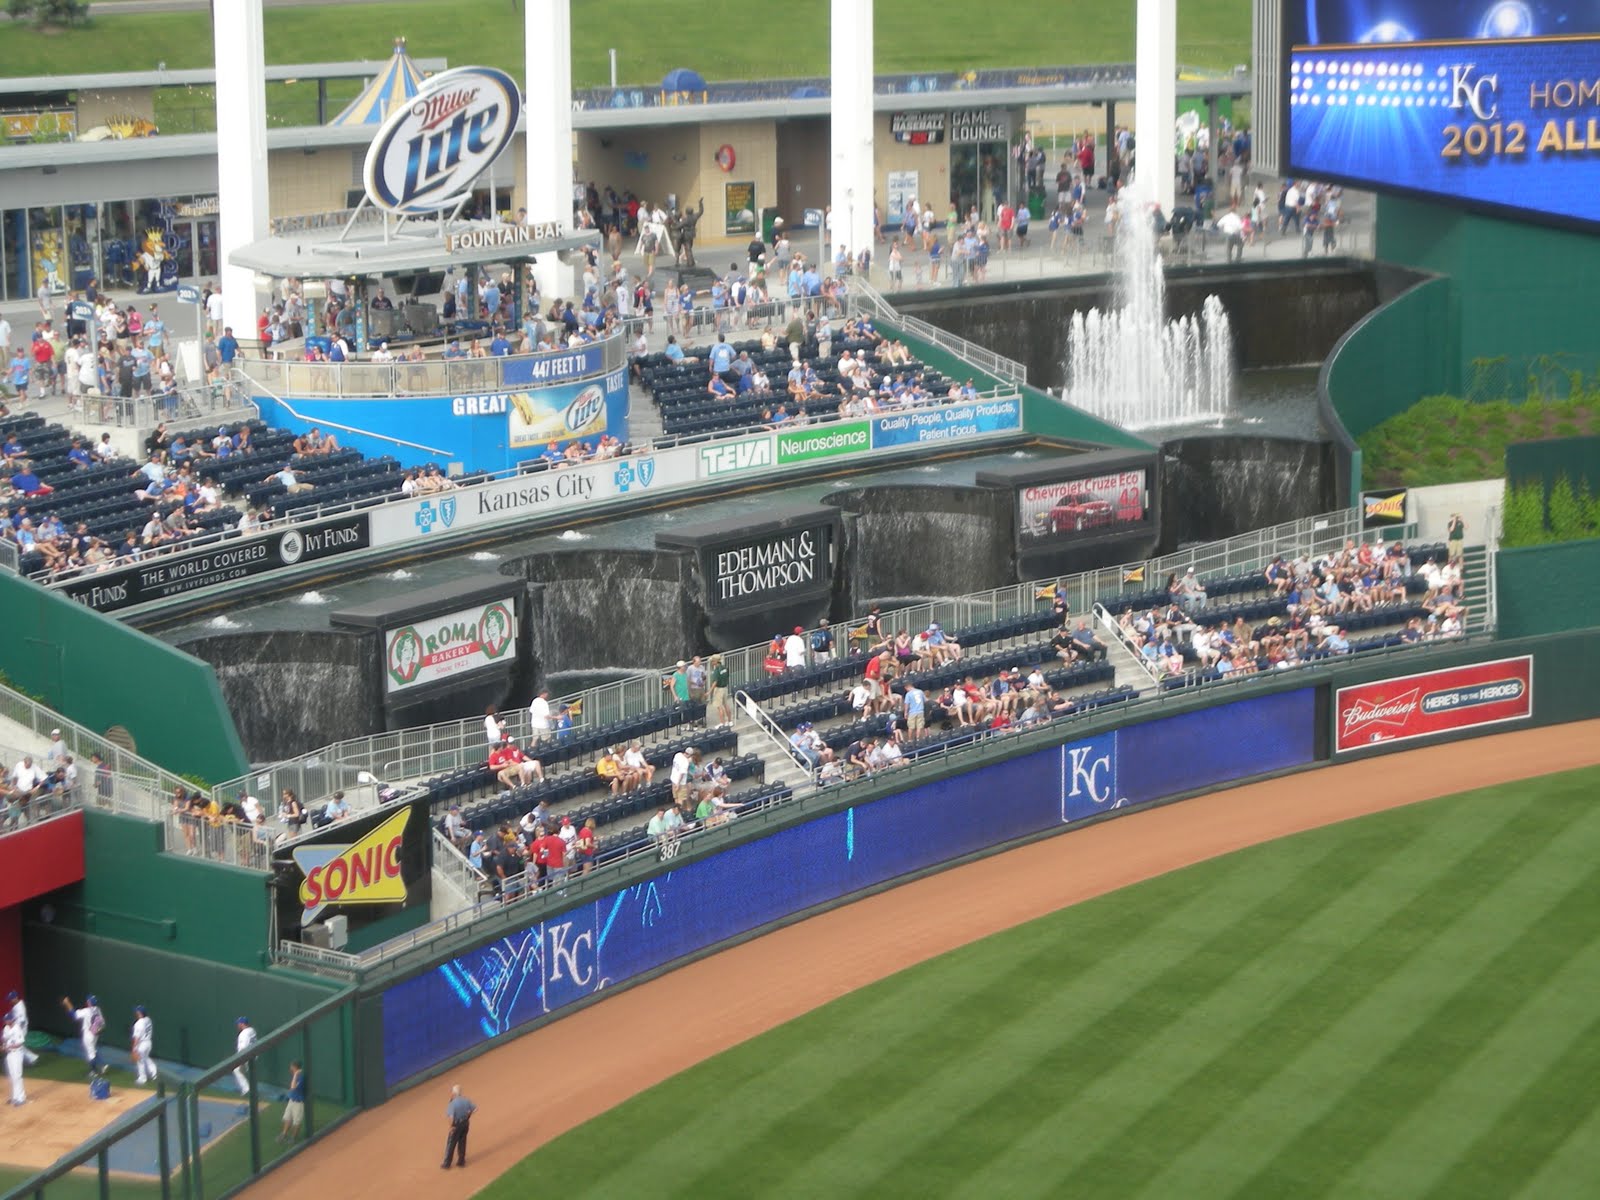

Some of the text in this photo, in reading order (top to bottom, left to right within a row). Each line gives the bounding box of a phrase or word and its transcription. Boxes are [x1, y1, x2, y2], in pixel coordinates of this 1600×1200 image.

[1449, 63, 1497, 120] KC
[1530, 79, 1600, 108] HOM
[412, 87, 480, 126] Miller
[952, 110, 991, 125] GAME
[892, 120, 944, 132] BASEBALL
[952, 124, 1006, 141] LOUNGE
[1441, 117, 1600, 156] 2012 ALL
[400, 102, 499, 206] Lite
[451, 221, 564, 251] FOUNTAIN BAR
[532, 354, 586, 378] 447 FEET TO
[606, 372, 624, 394] TASTE
[453, 394, 508, 416] GREAT
[574, 396, 600, 431] Lite
[880, 402, 1016, 431] Quality People, Quality Products,
[781, 430, 867, 457] Neuroscience
[920, 424, 977, 440] Patient Focus
[702, 438, 770, 474] TEVA
[477, 474, 595, 515] Kansas City
[1025, 473, 1138, 501] Chevrolet Cruze Eco
[1118, 487, 1139, 506] 42
[1366, 500, 1403, 514] SONIC
[305, 527, 358, 552] IVY FUNDS
[718, 530, 816, 577] EDELMAN &
[141, 545, 266, 586] THE WORLD COVERED
[717, 558, 814, 600] THOMPSON
[91, 584, 127, 607] FUNDS
[425, 622, 477, 654] ROMA
[431, 645, 471, 664] BAKERY
[1426, 693, 1459, 709] HERE'S
[1479, 683, 1519, 700] HEROES
[1343, 700, 1417, 727] Budweiser
[1068, 745, 1110, 803] KC
[660, 840, 681, 862] 387
[305, 835, 403, 910] SONIC
[548, 921, 593, 986] KC
